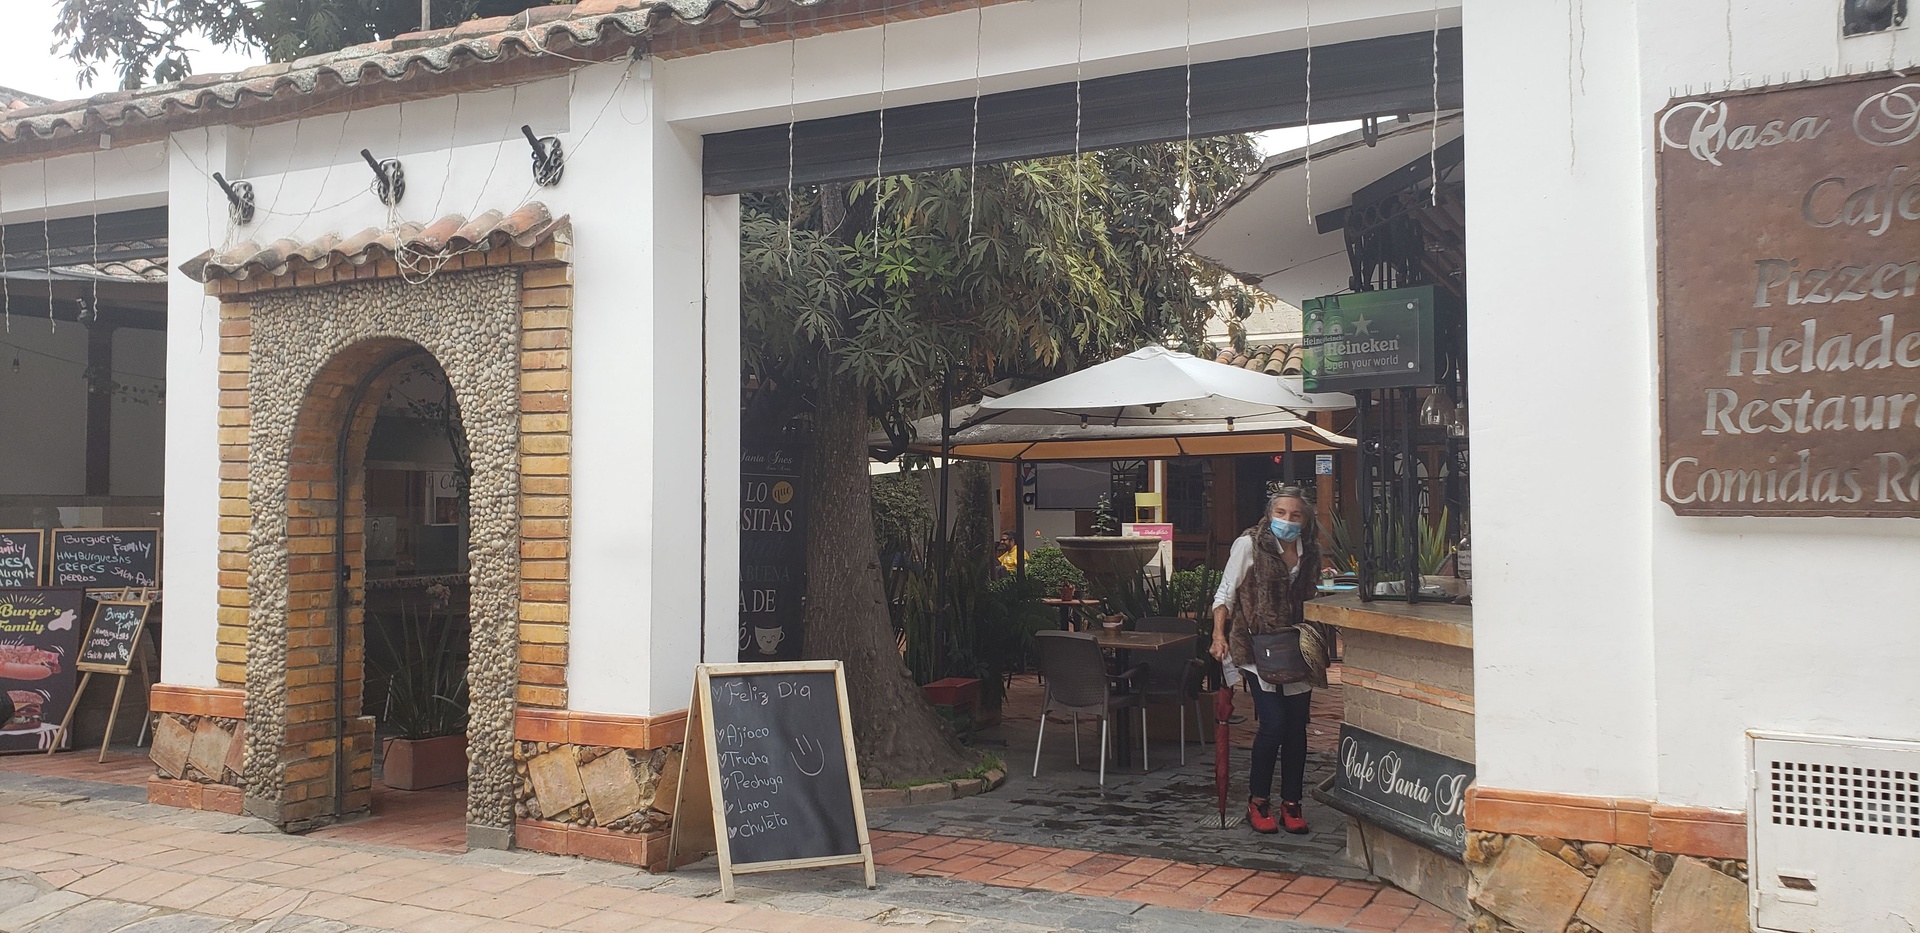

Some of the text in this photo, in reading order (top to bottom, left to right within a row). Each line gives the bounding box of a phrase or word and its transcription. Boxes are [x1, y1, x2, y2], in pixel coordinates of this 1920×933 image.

[1659, 100, 1831, 166] Casa
[1325, 338, 1400, 356] Heineken
[1352, 359, 1371, 370] your
[1373, 355, 1399, 366] world
[1702, 387, 1920, 436] Restaur
[1664, 449, 1862, 504] Comidas
[745, 481, 768, 503] LO
[0, 603, 62, 620] Burger's
[752, 589, 776, 613] DE
[725, 681, 769, 706] Feliz
[725, 750, 770, 768] Trucha
[1341, 735, 1376, 791] Café
[1377, 750, 1432, 804] Santa
[730, 770, 784, 795] Pechuga
[738, 799, 770, 815] Lomo
